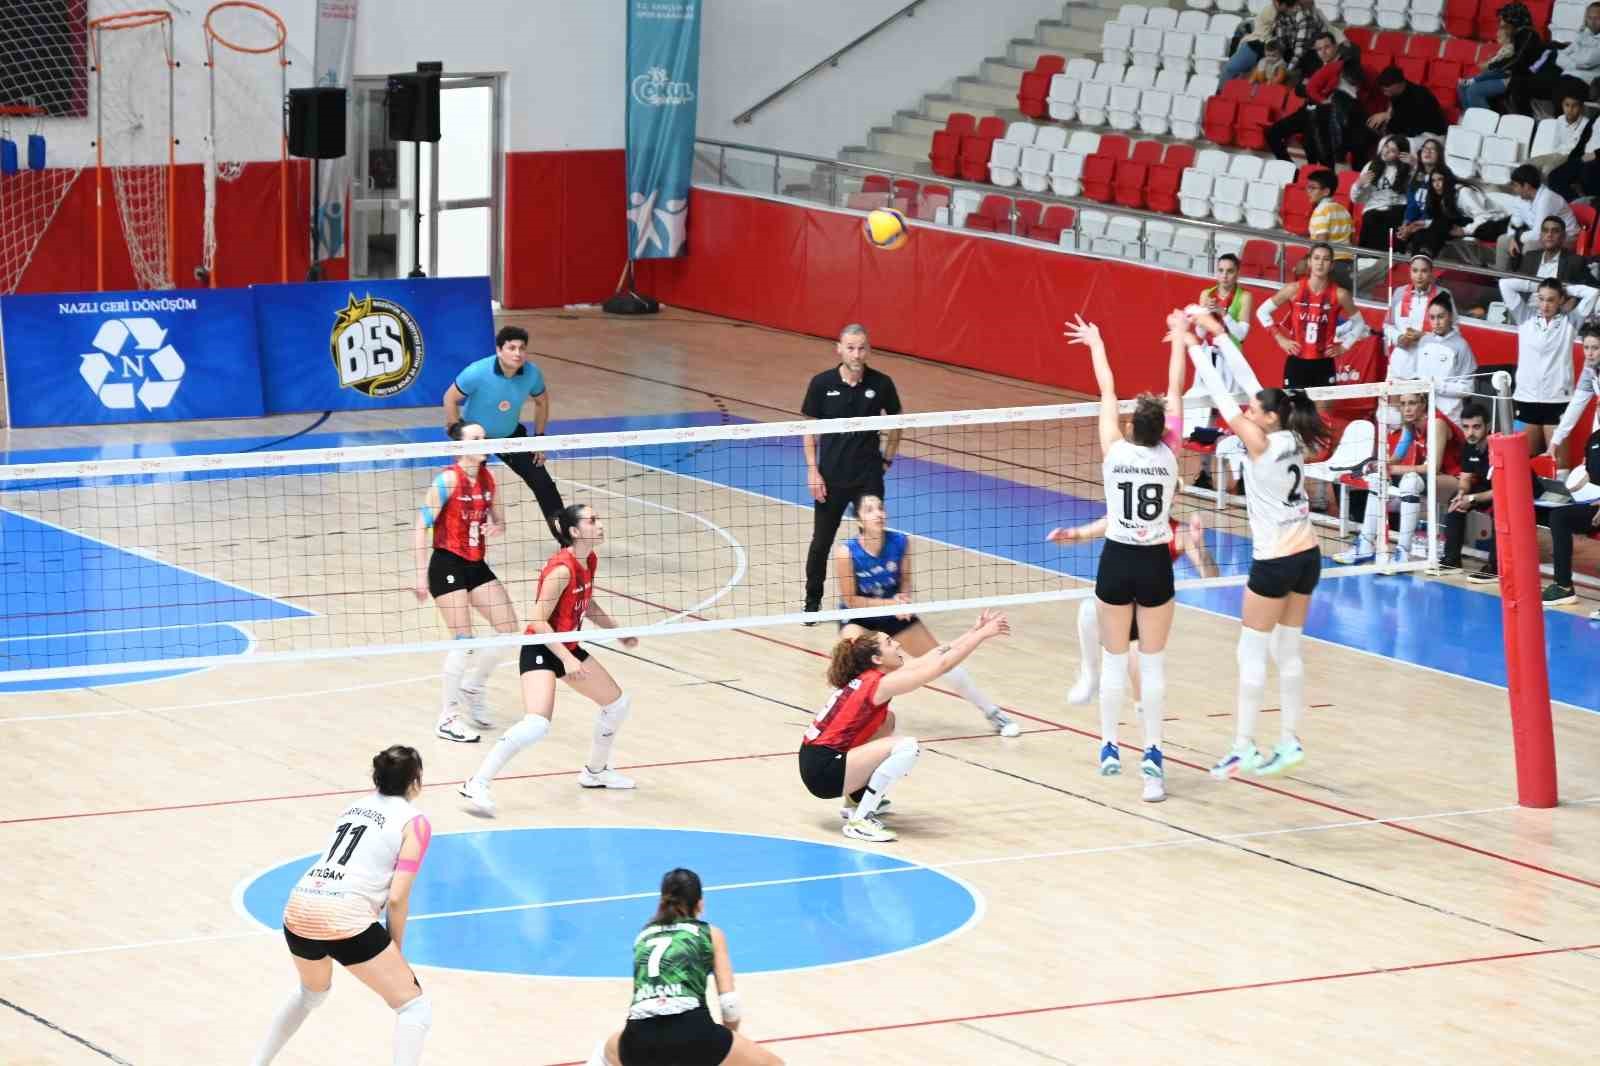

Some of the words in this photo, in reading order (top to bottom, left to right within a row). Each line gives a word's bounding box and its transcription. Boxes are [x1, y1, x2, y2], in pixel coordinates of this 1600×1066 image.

[59, 302, 99, 314] NAZLI
[100, 300, 130, 312] GERİ
[132, 298, 197, 312] DÖNÜŞÜM
[338, 315, 405, 385] BES
[1305, 322, 1319, 344] 6
[120, 355, 144, 377] N
[1117, 481, 1164, 521] 18
[1287, 464, 1302, 502] 2
[535, 655, 544, 665] 8
[325, 822, 368, 866] 11
[646, 936, 673, 978] 7
